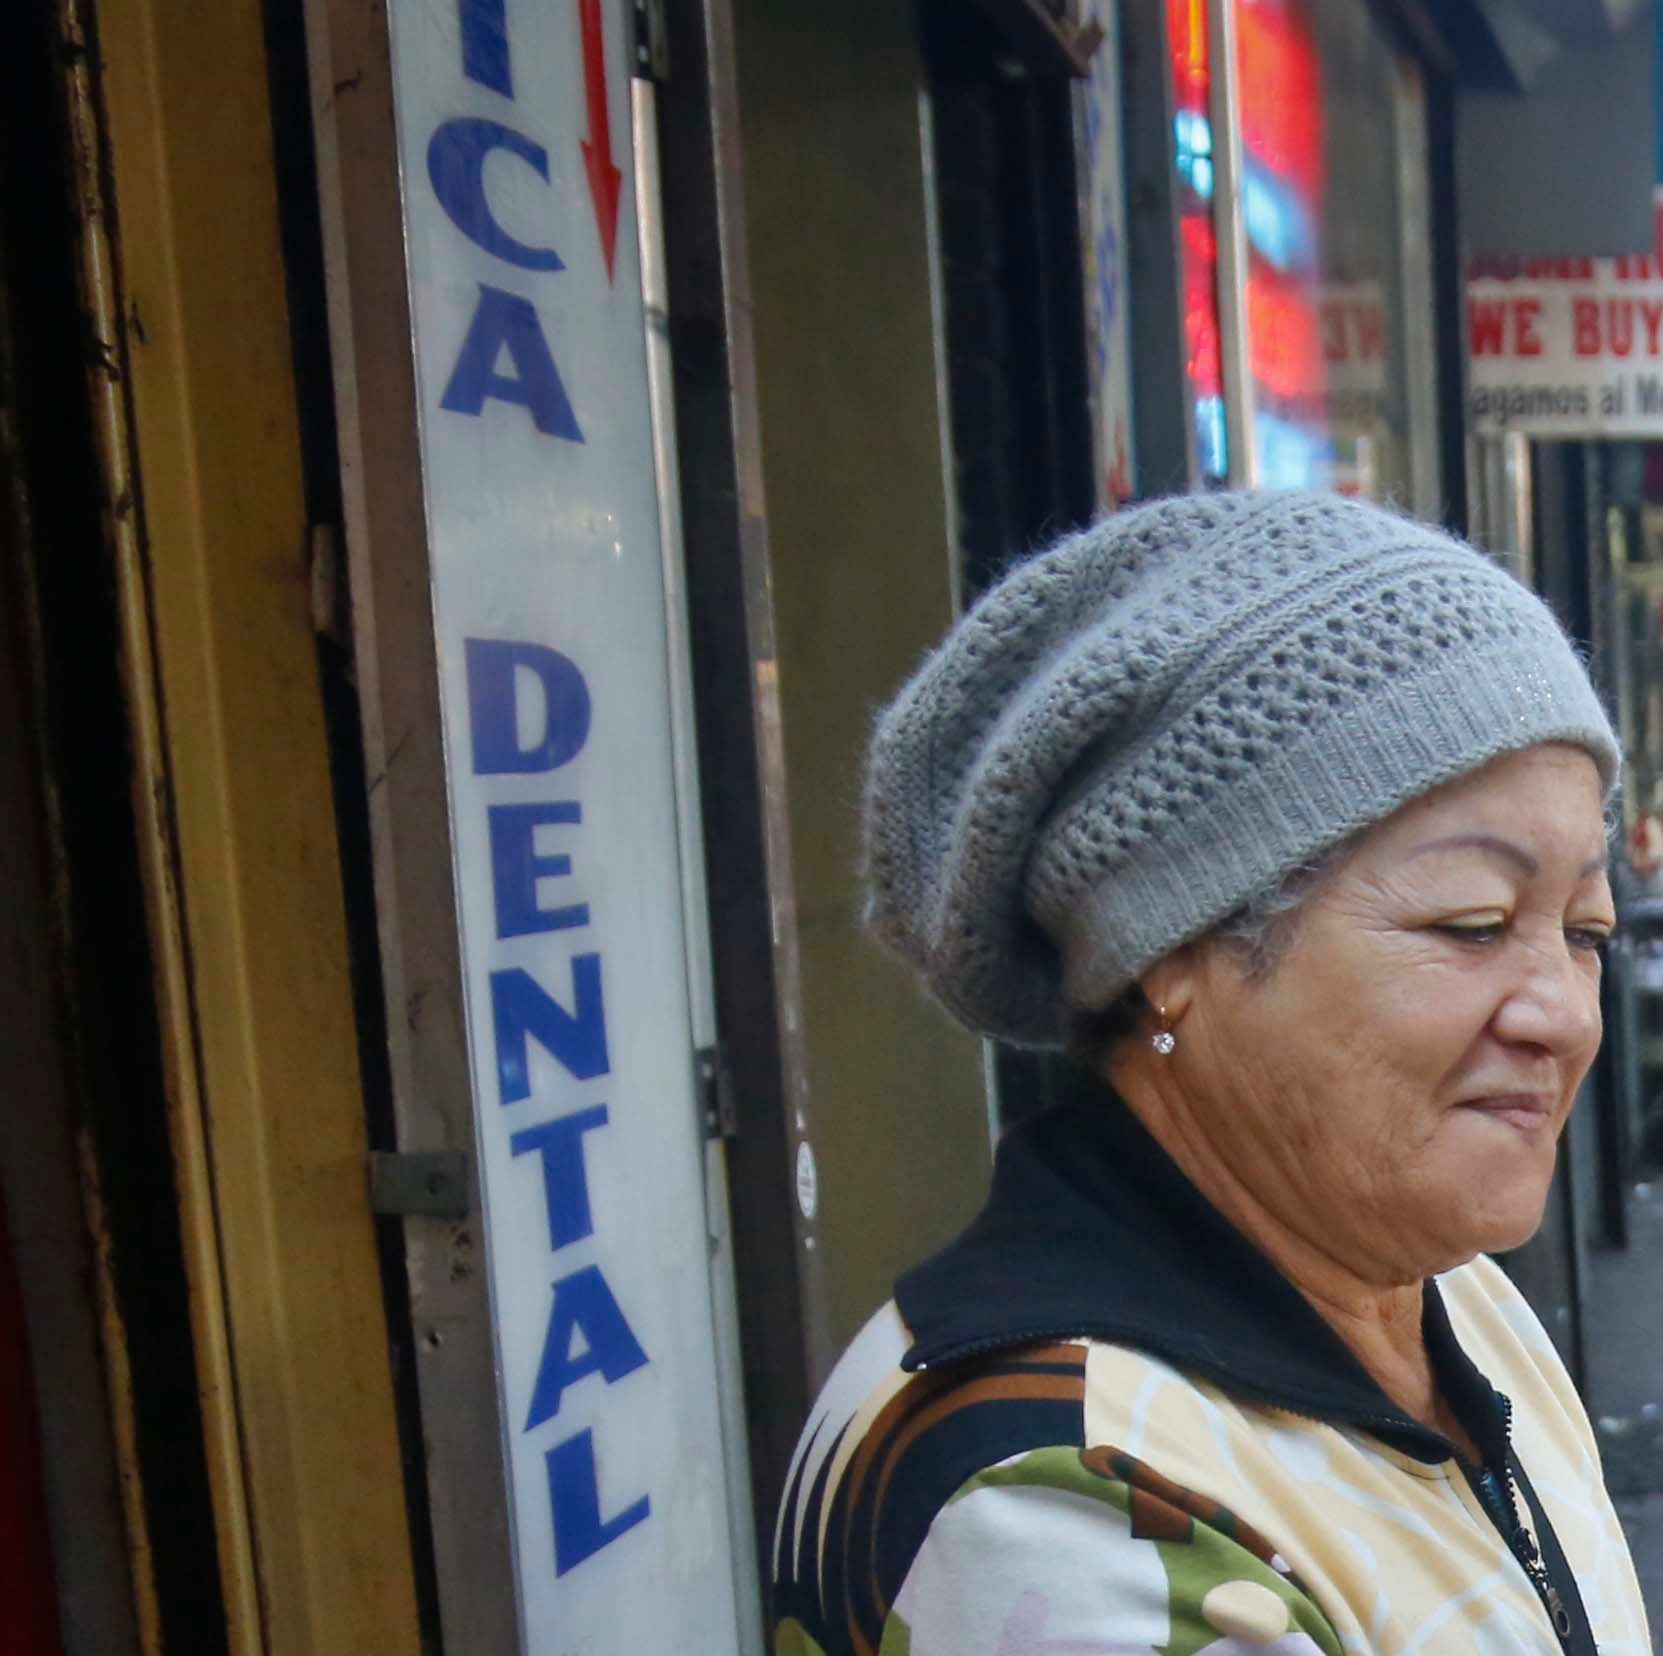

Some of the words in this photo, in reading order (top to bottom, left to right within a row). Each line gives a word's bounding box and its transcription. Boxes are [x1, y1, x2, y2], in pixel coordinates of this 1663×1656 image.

[1468, 298, 1541, 357] WE
[1573, 298, 1663, 358] BUY
[1470, 384, 1588, 427] agamos
[1601, 373, 1625, 416] al
[464, 637, 650, 1578] DENTAL
